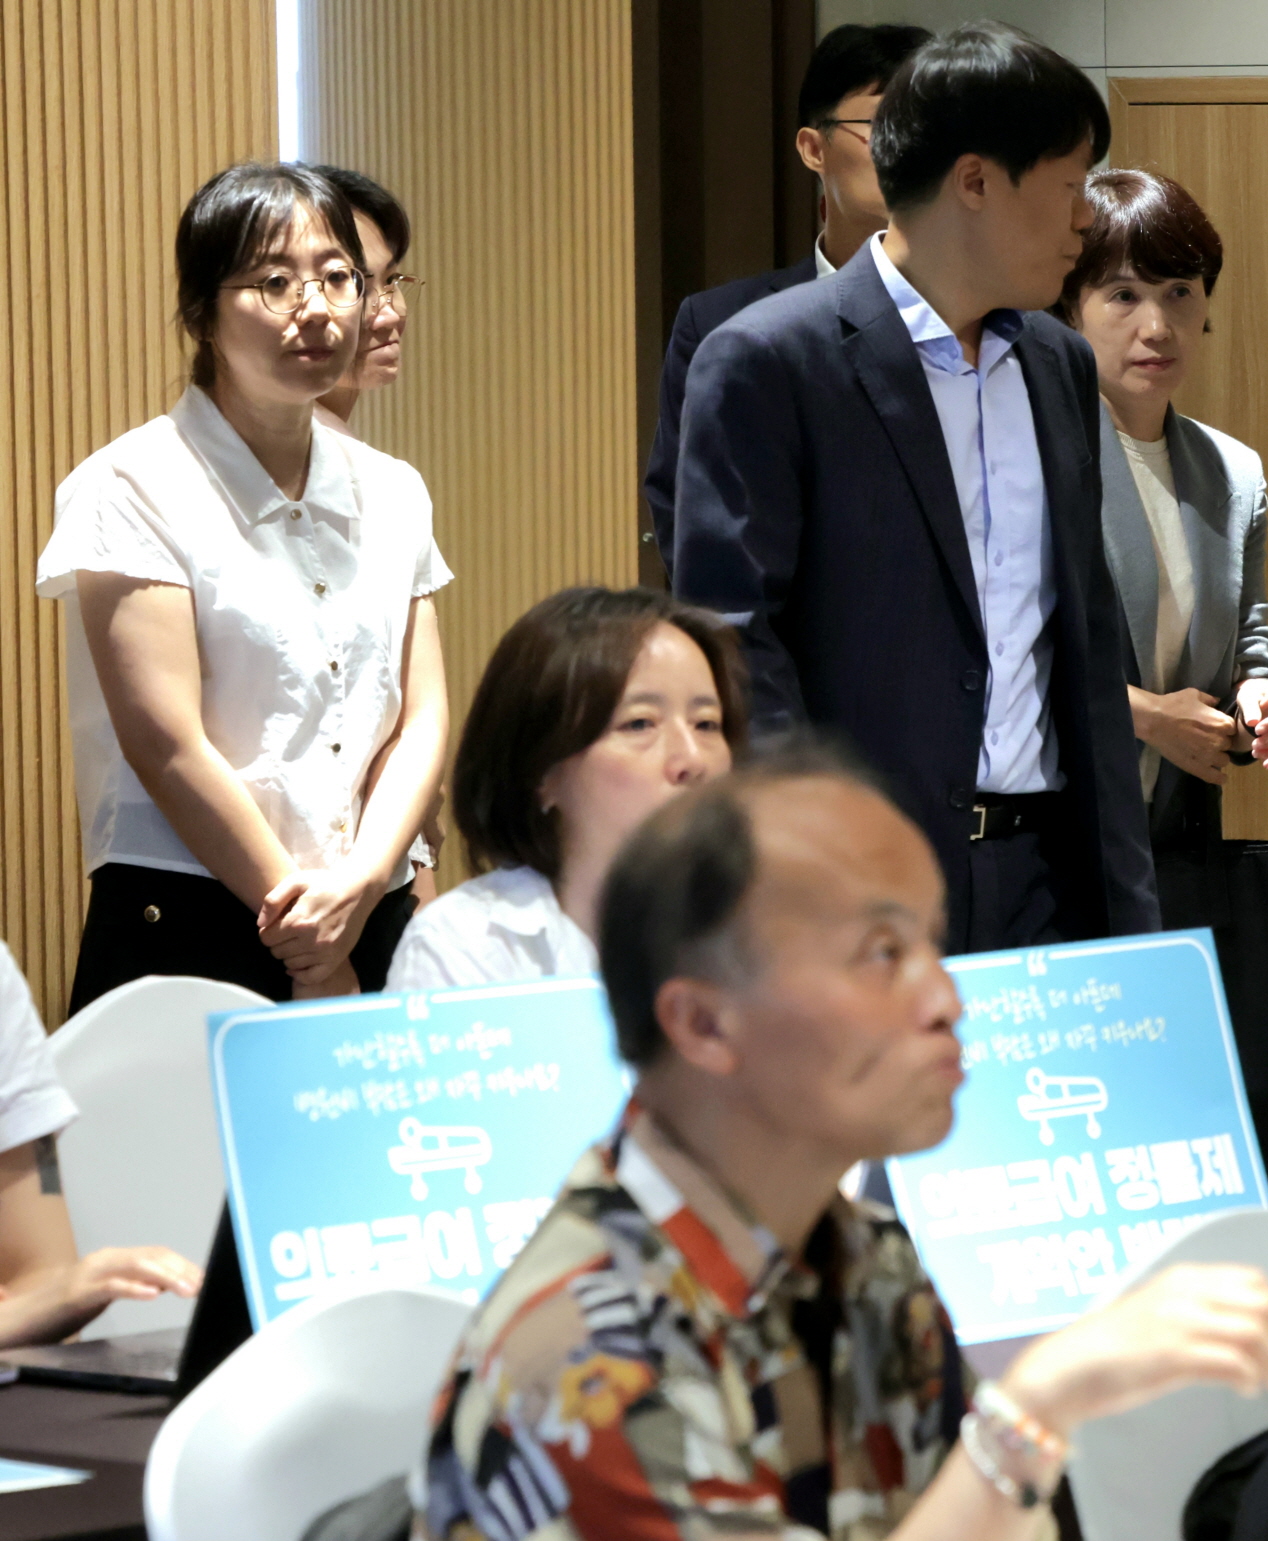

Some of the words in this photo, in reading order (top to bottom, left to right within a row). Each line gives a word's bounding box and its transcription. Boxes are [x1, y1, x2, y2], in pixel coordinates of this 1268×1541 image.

[918, 1152, 1108, 1240] 의료급여
[1104, 1132, 1246, 1212] 정률제
[270, 1206, 483, 1302] 의료급여
